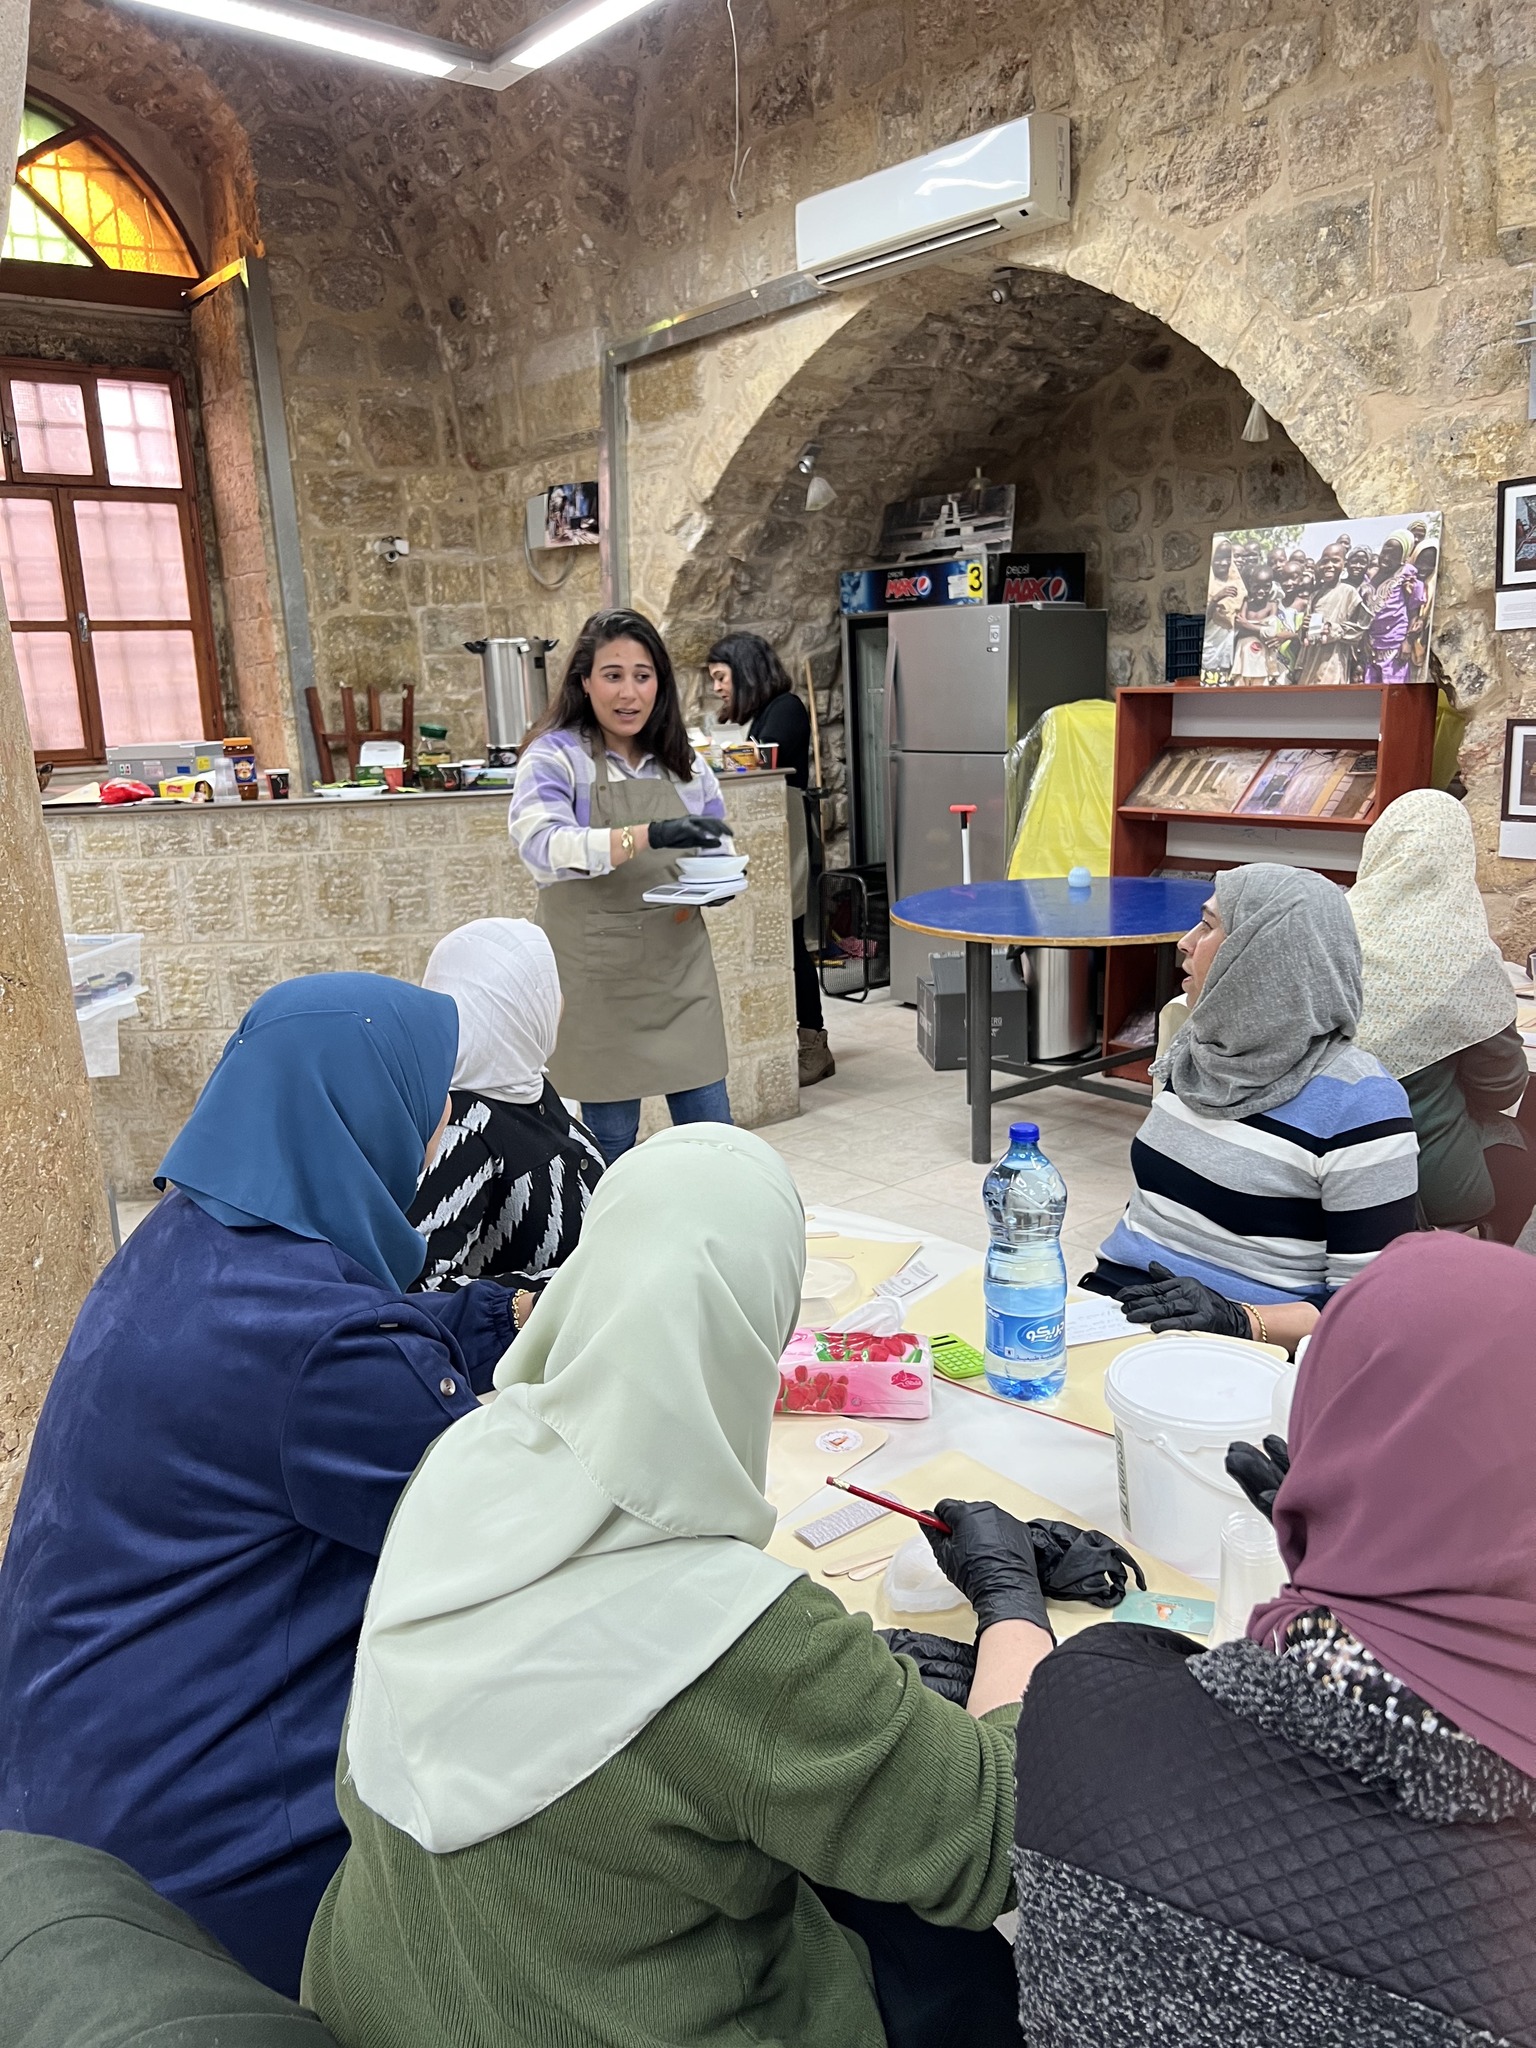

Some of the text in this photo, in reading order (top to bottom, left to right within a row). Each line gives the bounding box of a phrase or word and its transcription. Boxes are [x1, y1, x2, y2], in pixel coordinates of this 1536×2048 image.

[969, 566, 982, 592] 3
[1006, 563, 1030, 577] pepsi
[886, 577, 919, 598] MAX
[1002, 577, 1051, 603] MAX
[1026, 1321, 1065, 1342] جريكو
[1116, 1432, 1129, 1525] JESMONTE
